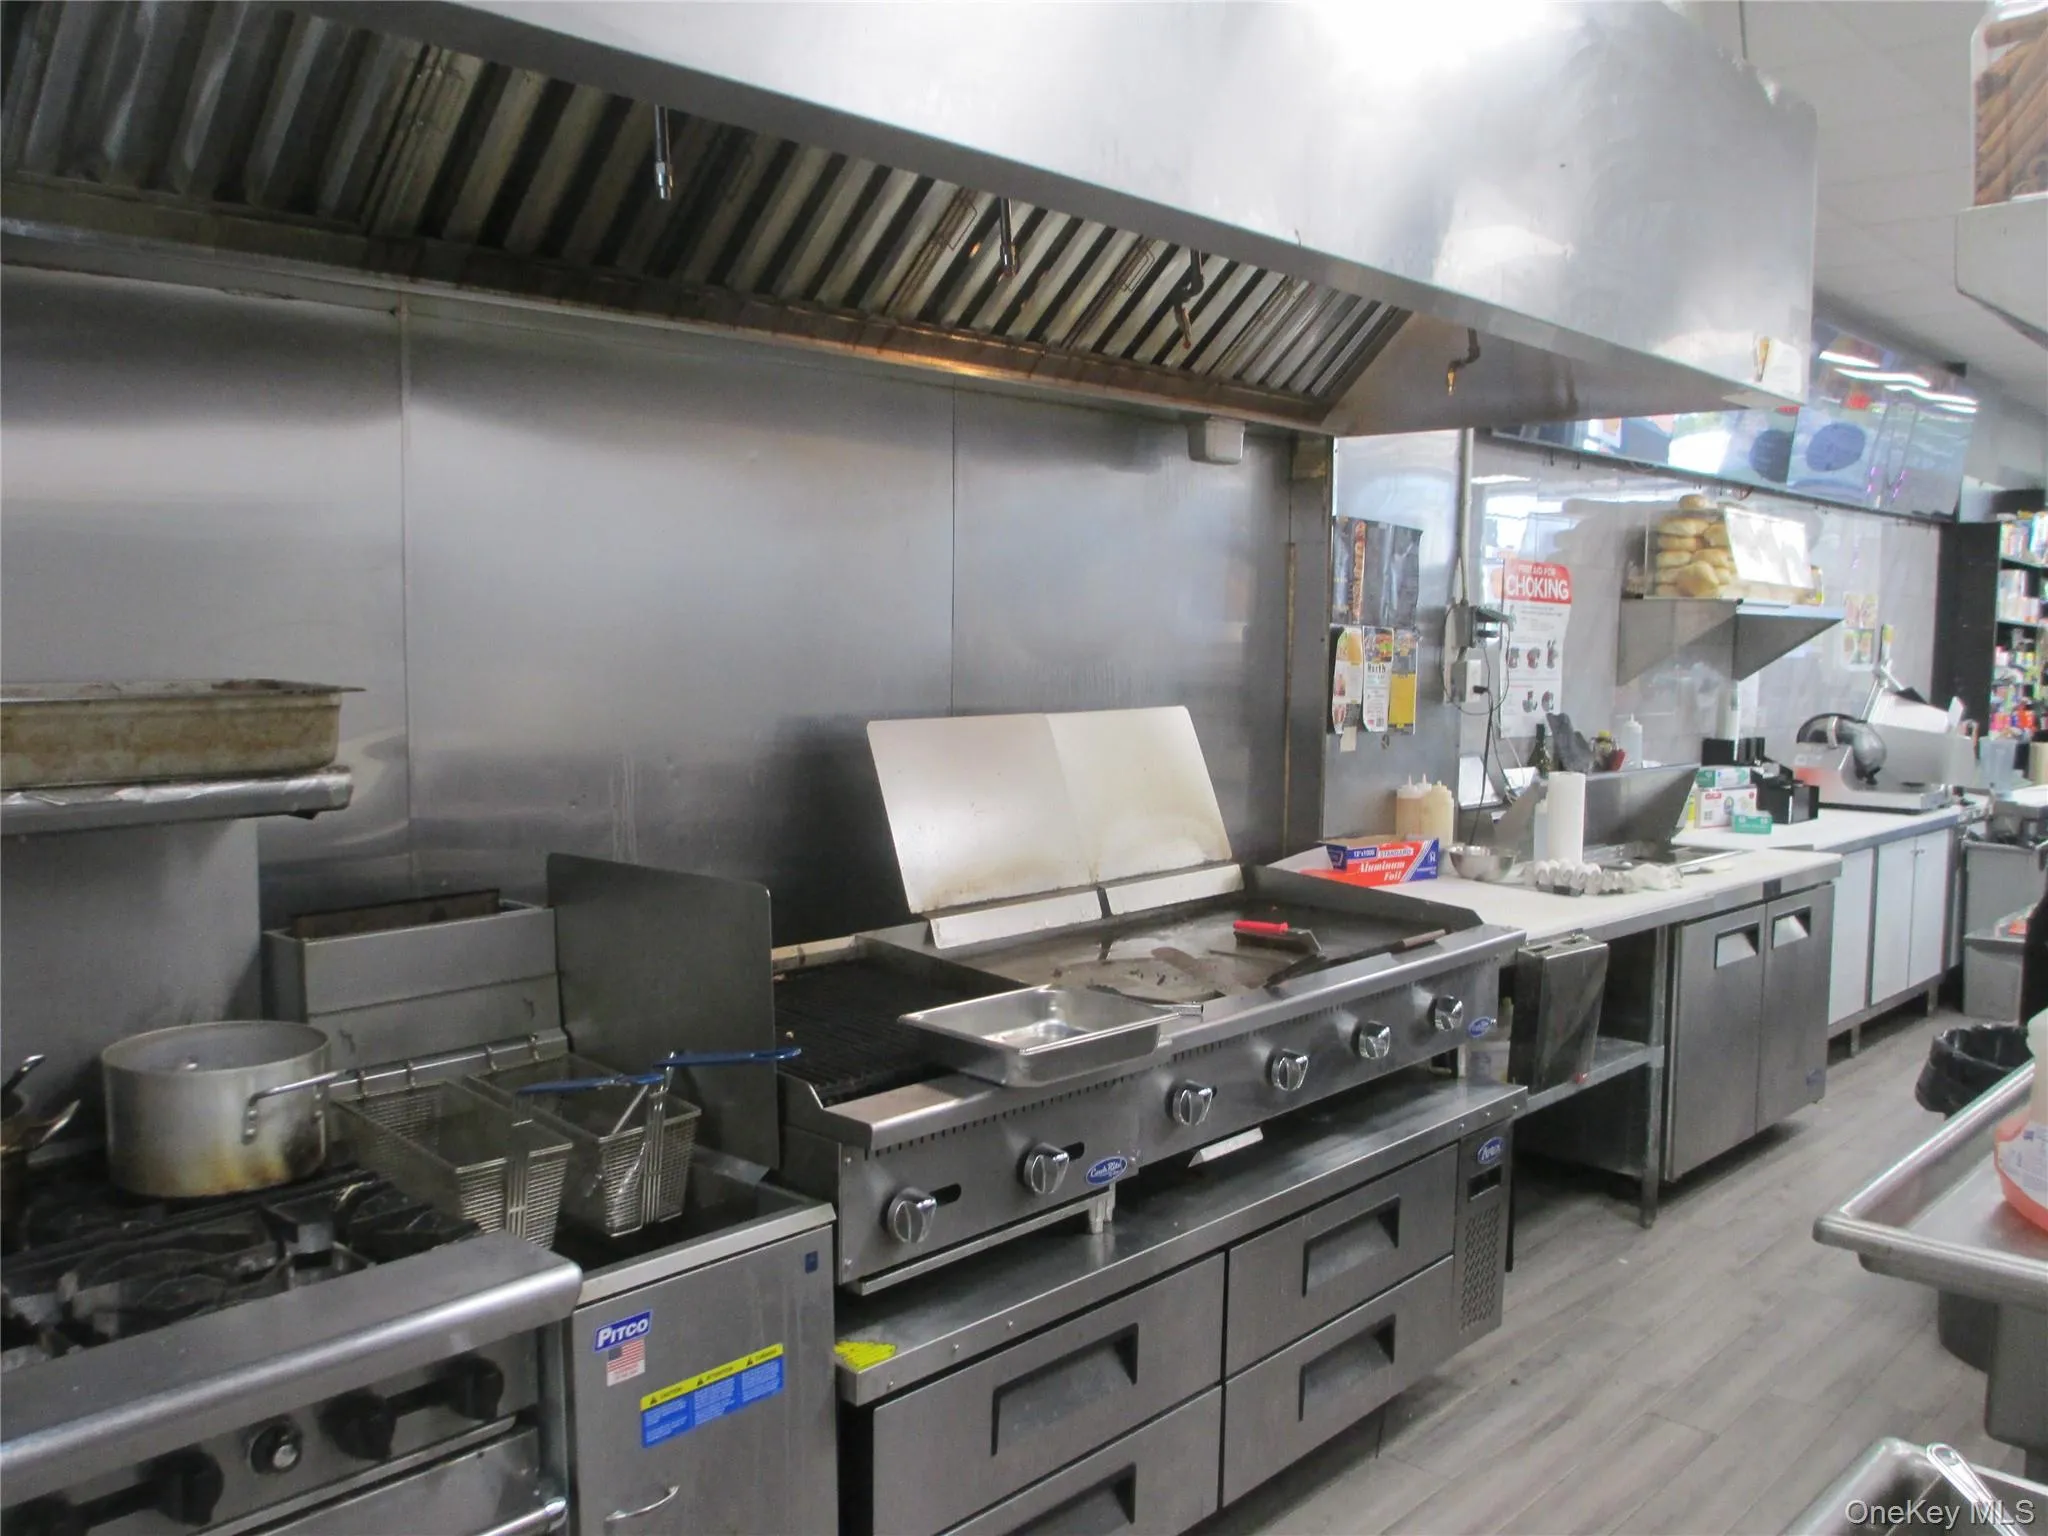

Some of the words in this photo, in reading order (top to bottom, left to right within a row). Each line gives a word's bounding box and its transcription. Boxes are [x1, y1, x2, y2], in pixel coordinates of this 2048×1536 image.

[1506, 574, 1569, 600] CHOKING
[1360, 861, 1405, 873] Aluminum
[1384, 871, 1402, 882] Foil
[597, 1318, 649, 1348] PITCO
